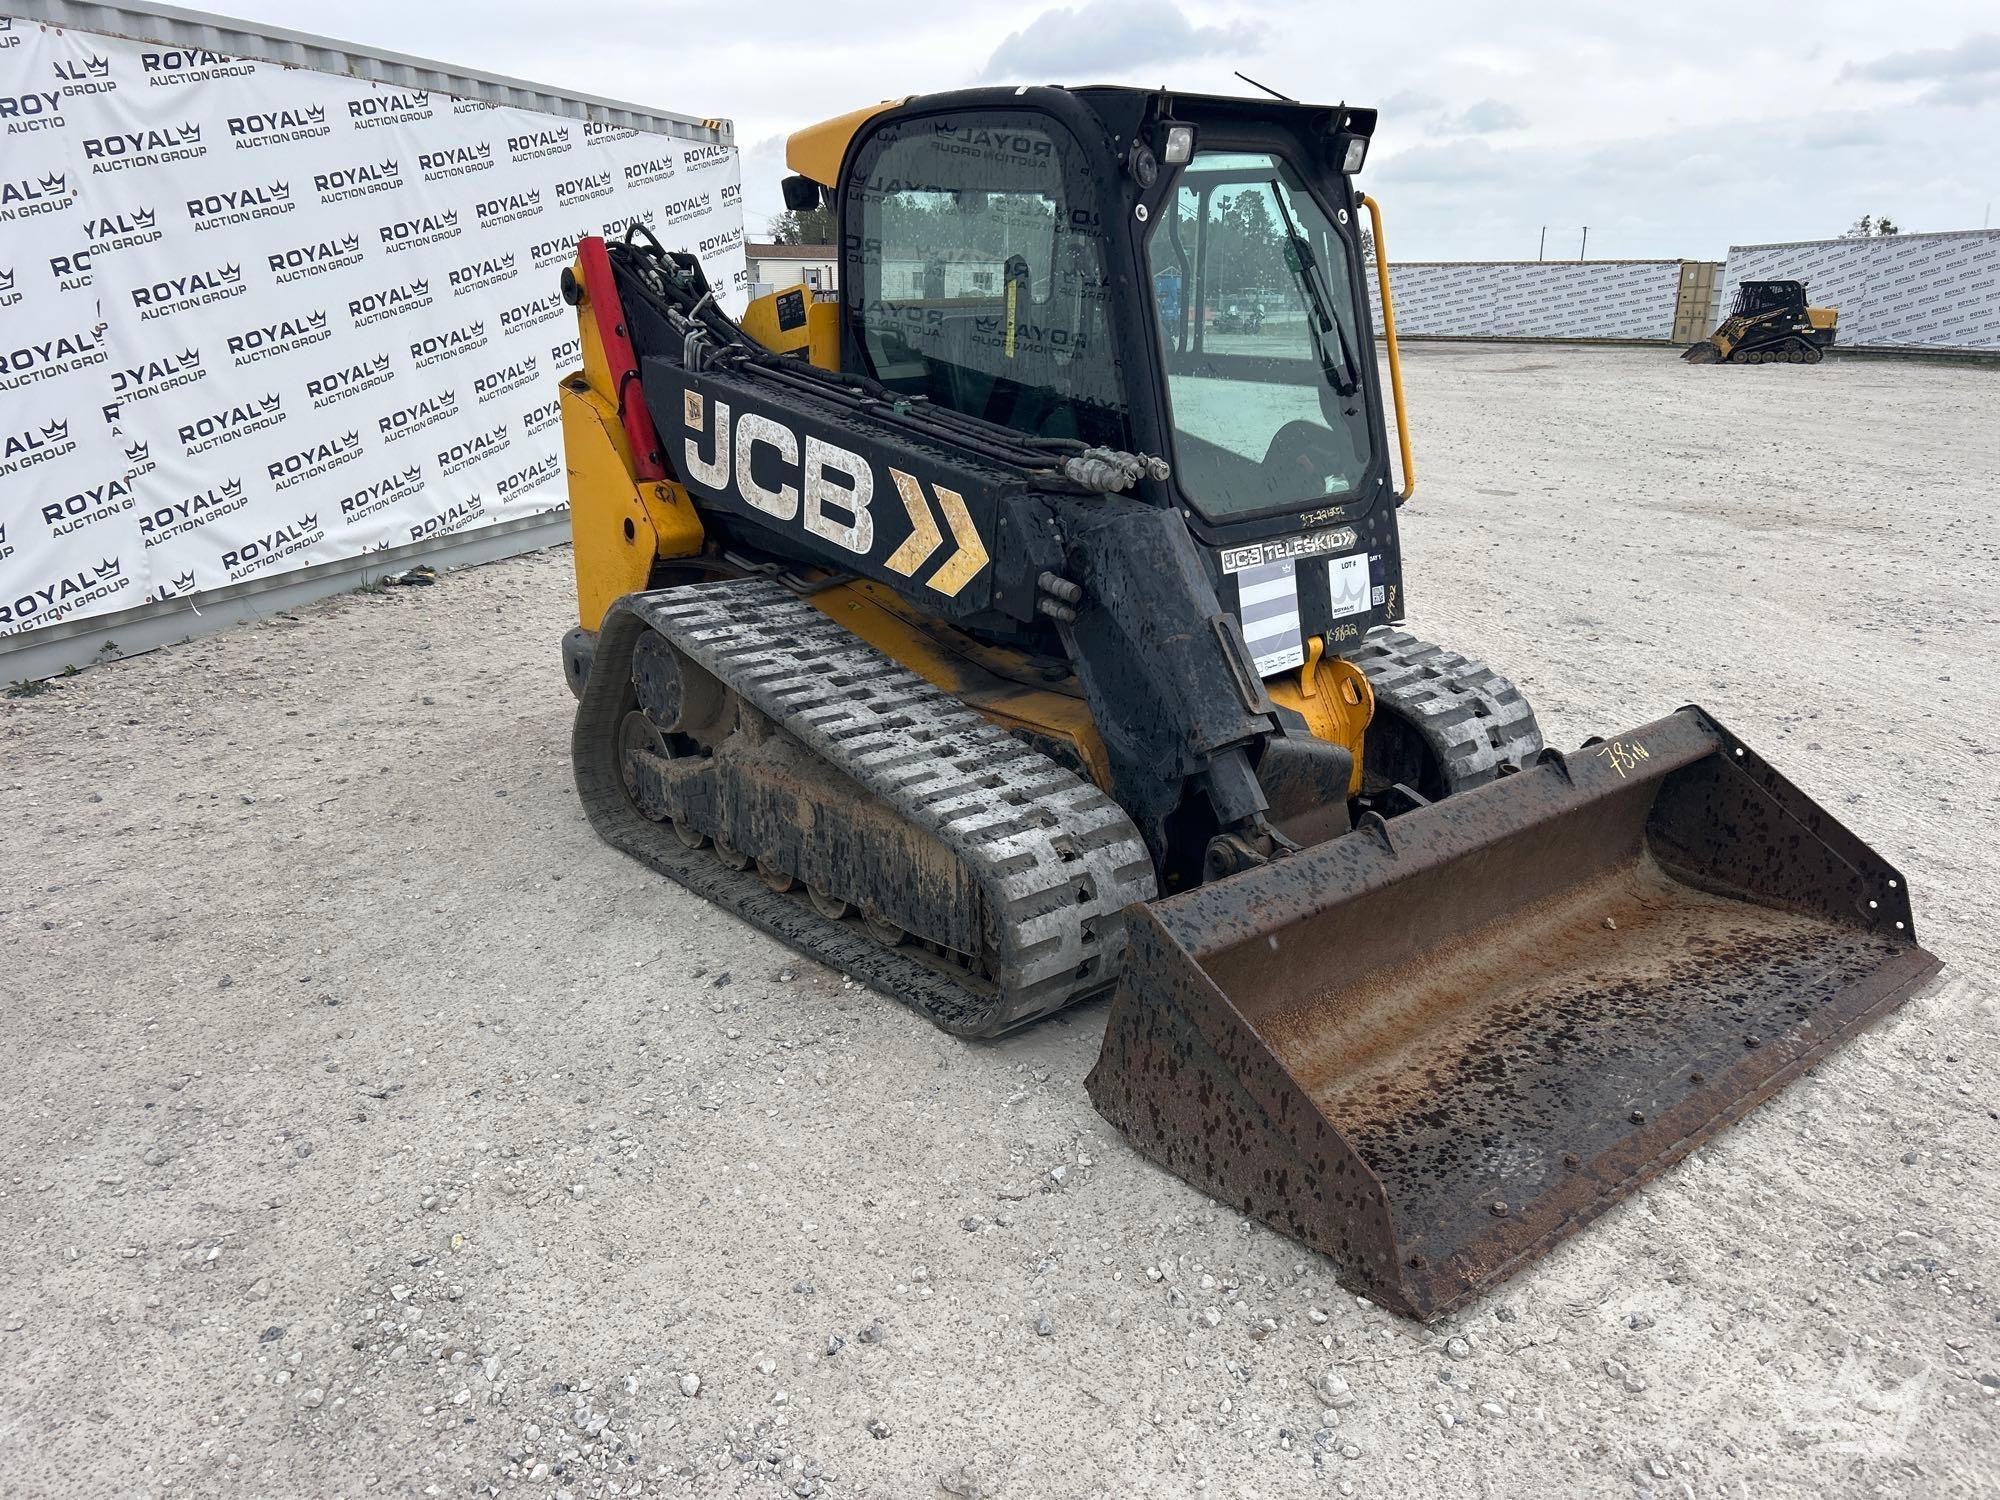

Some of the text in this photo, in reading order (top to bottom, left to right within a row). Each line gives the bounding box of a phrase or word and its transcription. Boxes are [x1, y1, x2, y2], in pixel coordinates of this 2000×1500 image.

[62, 82, 116, 96] GROUP
[150, 66, 255, 86] AUCTION GROUP
[348, 95, 414, 117] ROYAL
[355, 110, 433, 130] AUCTION GROUP
[227, 110, 308, 136] ROYAL
[587, 128, 639, 146] AUCTION GROUP
[83, 129, 180, 159] ROYAL
[236, 126, 330, 150] AUCTION GROUP
[508, 131, 558, 152] ROYAL
[93, 146, 206, 174] AUCTION GROUP
[418, 147, 478, 170] ROYAL
[512, 144, 572, 163] AUCTION GROUP
[687, 156, 729, 172] AUCTION GROUP
[314, 165, 382, 192] ROYAL
[425, 160, 494, 182] AUCTION GROUP
[624, 160, 664, 179] ROYAL
[628, 171, 674, 189] AUCTION GROUP
[322, 179, 403, 204] AUCTION GROUP
[555, 176, 601, 197] ROYAL
[560, 187, 614, 207] AUCTION GROUP
[18, 198, 72, 218] GROUP
[187, 188, 271, 218] ROYAL
[476, 194, 528, 218] ROYAL
[665, 197, 701, 217] ROYAL
[669, 207, 712, 225] AUCTION GROUP
[195, 203, 295, 232] AUCTION GROUP
[380, 216, 444, 242] ROYAL
[481, 206, 543, 229] AUCTION GROUP
[112, 231, 162, 250] GROUP
[386, 228, 461, 254] AUCTION GROUP
[531, 234, 577, 260] ROYAL
[699, 232, 733, 252] ROYAL
[703, 241, 742, 260] AUCTION GROUP
[268, 241, 344, 272] ROYAL
[276, 254, 363, 284] AUCTION GROUP
[535, 256, 561, 270] AUCTION
[449, 259, 502, 286] ROYAL
[454, 270, 518, 296] AUCTION GROUP
[131, 272, 221, 307] ROYAL
[141, 285, 246, 321] AUCTION GROUP
[348, 286, 412, 317] ROYAL
[355, 297, 433, 328] AUCTION GROUP
[500, 299, 550, 326] ROYAL
[505, 308, 564, 336] AUCTION GROUP
[227, 319, 309, 354] ROYAL
[235, 330, 331, 367] AUCTION GROUP
[410, 328, 472, 358] ROYAL
[416, 338, 488, 370] AUCTION GROUP
[160, 370, 206, 391] GROUP
[307, 362, 374, 398] ROYAL
[314, 372, 394, 410] AUCTION GROUP
[474, 364, 525, 394] ROYAL
[479, 372, 539, 404] AUCTION GROUP
[178, 404, 262, 444] ROYAL
[379, 399, 440, 433] ROYAL
[385, 407, 458, 444] AUCTION GROUP
[528, 418, 558, 437] AUCTION
[187, 413, 286, 457] AUCTION GROUP
[20, 442, 76, 468] GROUP
[268, 440, 344, 480] ROYAL
[438, 433, 495, 467] ROYAL
[444, 440, 510, 477] AUCTION GROUP
[276, 448, 363, 492] AUCTION GROUP
[497, 462, 546, 495] ROYAL
[684, 389, 874, 554] JCB
[340, 475, 405, 514] ROYAL
[504, 468, 560, 504] AUCTION GROUP
[139, 490, 223, 535] ROYAL
[347, 482, 424, 525] AUCTION GROUP
[54, 504, 120, 538] AUCTION
[145, 497, 248, 549] AUCTION GROUP
[410, 504, 468, 540] ROYAL
[456, 509, 484, 528] GROUP
[222, 525, 302, 570] ROYAL
[231, 531, 324, 579] AUCTION GROUP
[1224, 533, 1342, 568] JCB TELESKID
[1342, 561, 1352, 569] LOT
[74, 578, 129, 607] GROUP
